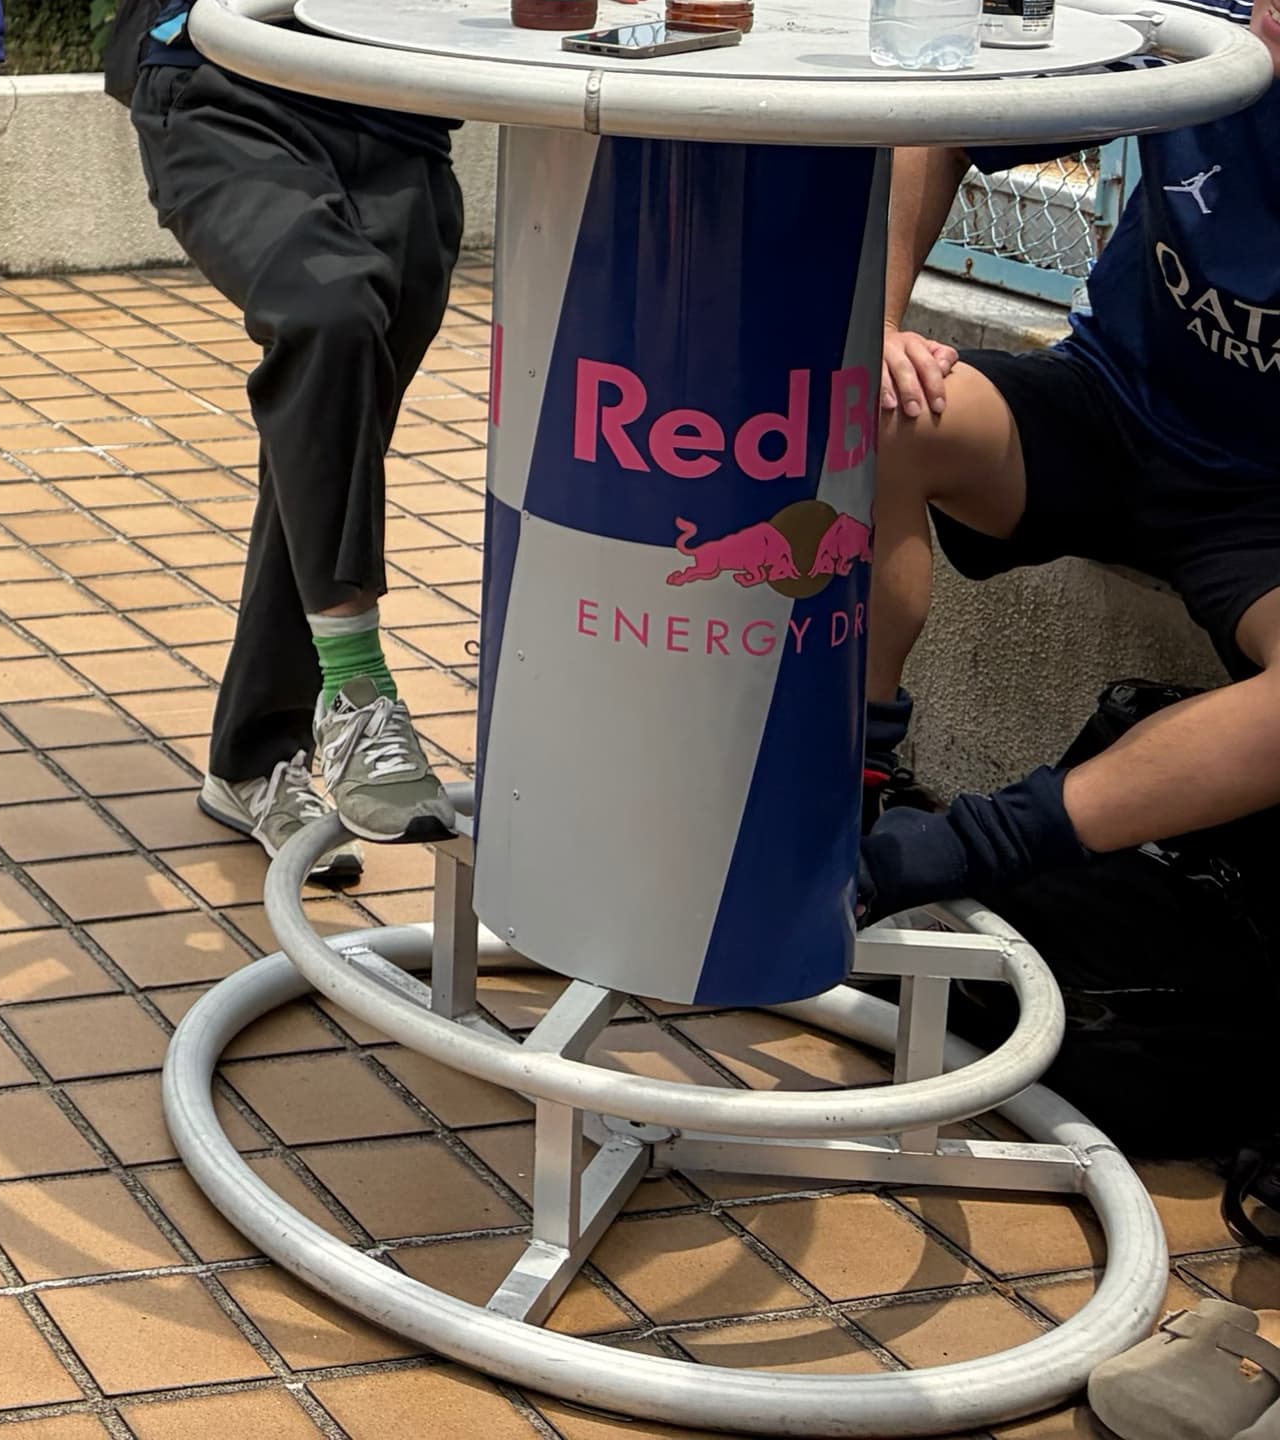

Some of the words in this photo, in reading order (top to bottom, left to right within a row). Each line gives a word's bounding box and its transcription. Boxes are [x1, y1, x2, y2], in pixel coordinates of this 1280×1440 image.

[1155, 241, 1280, 348] QAT
[1186, 317, 1280, 373] AIRW
[573, 357, 811, 481] Red
[577, 599, 812, 656] ENERGY
